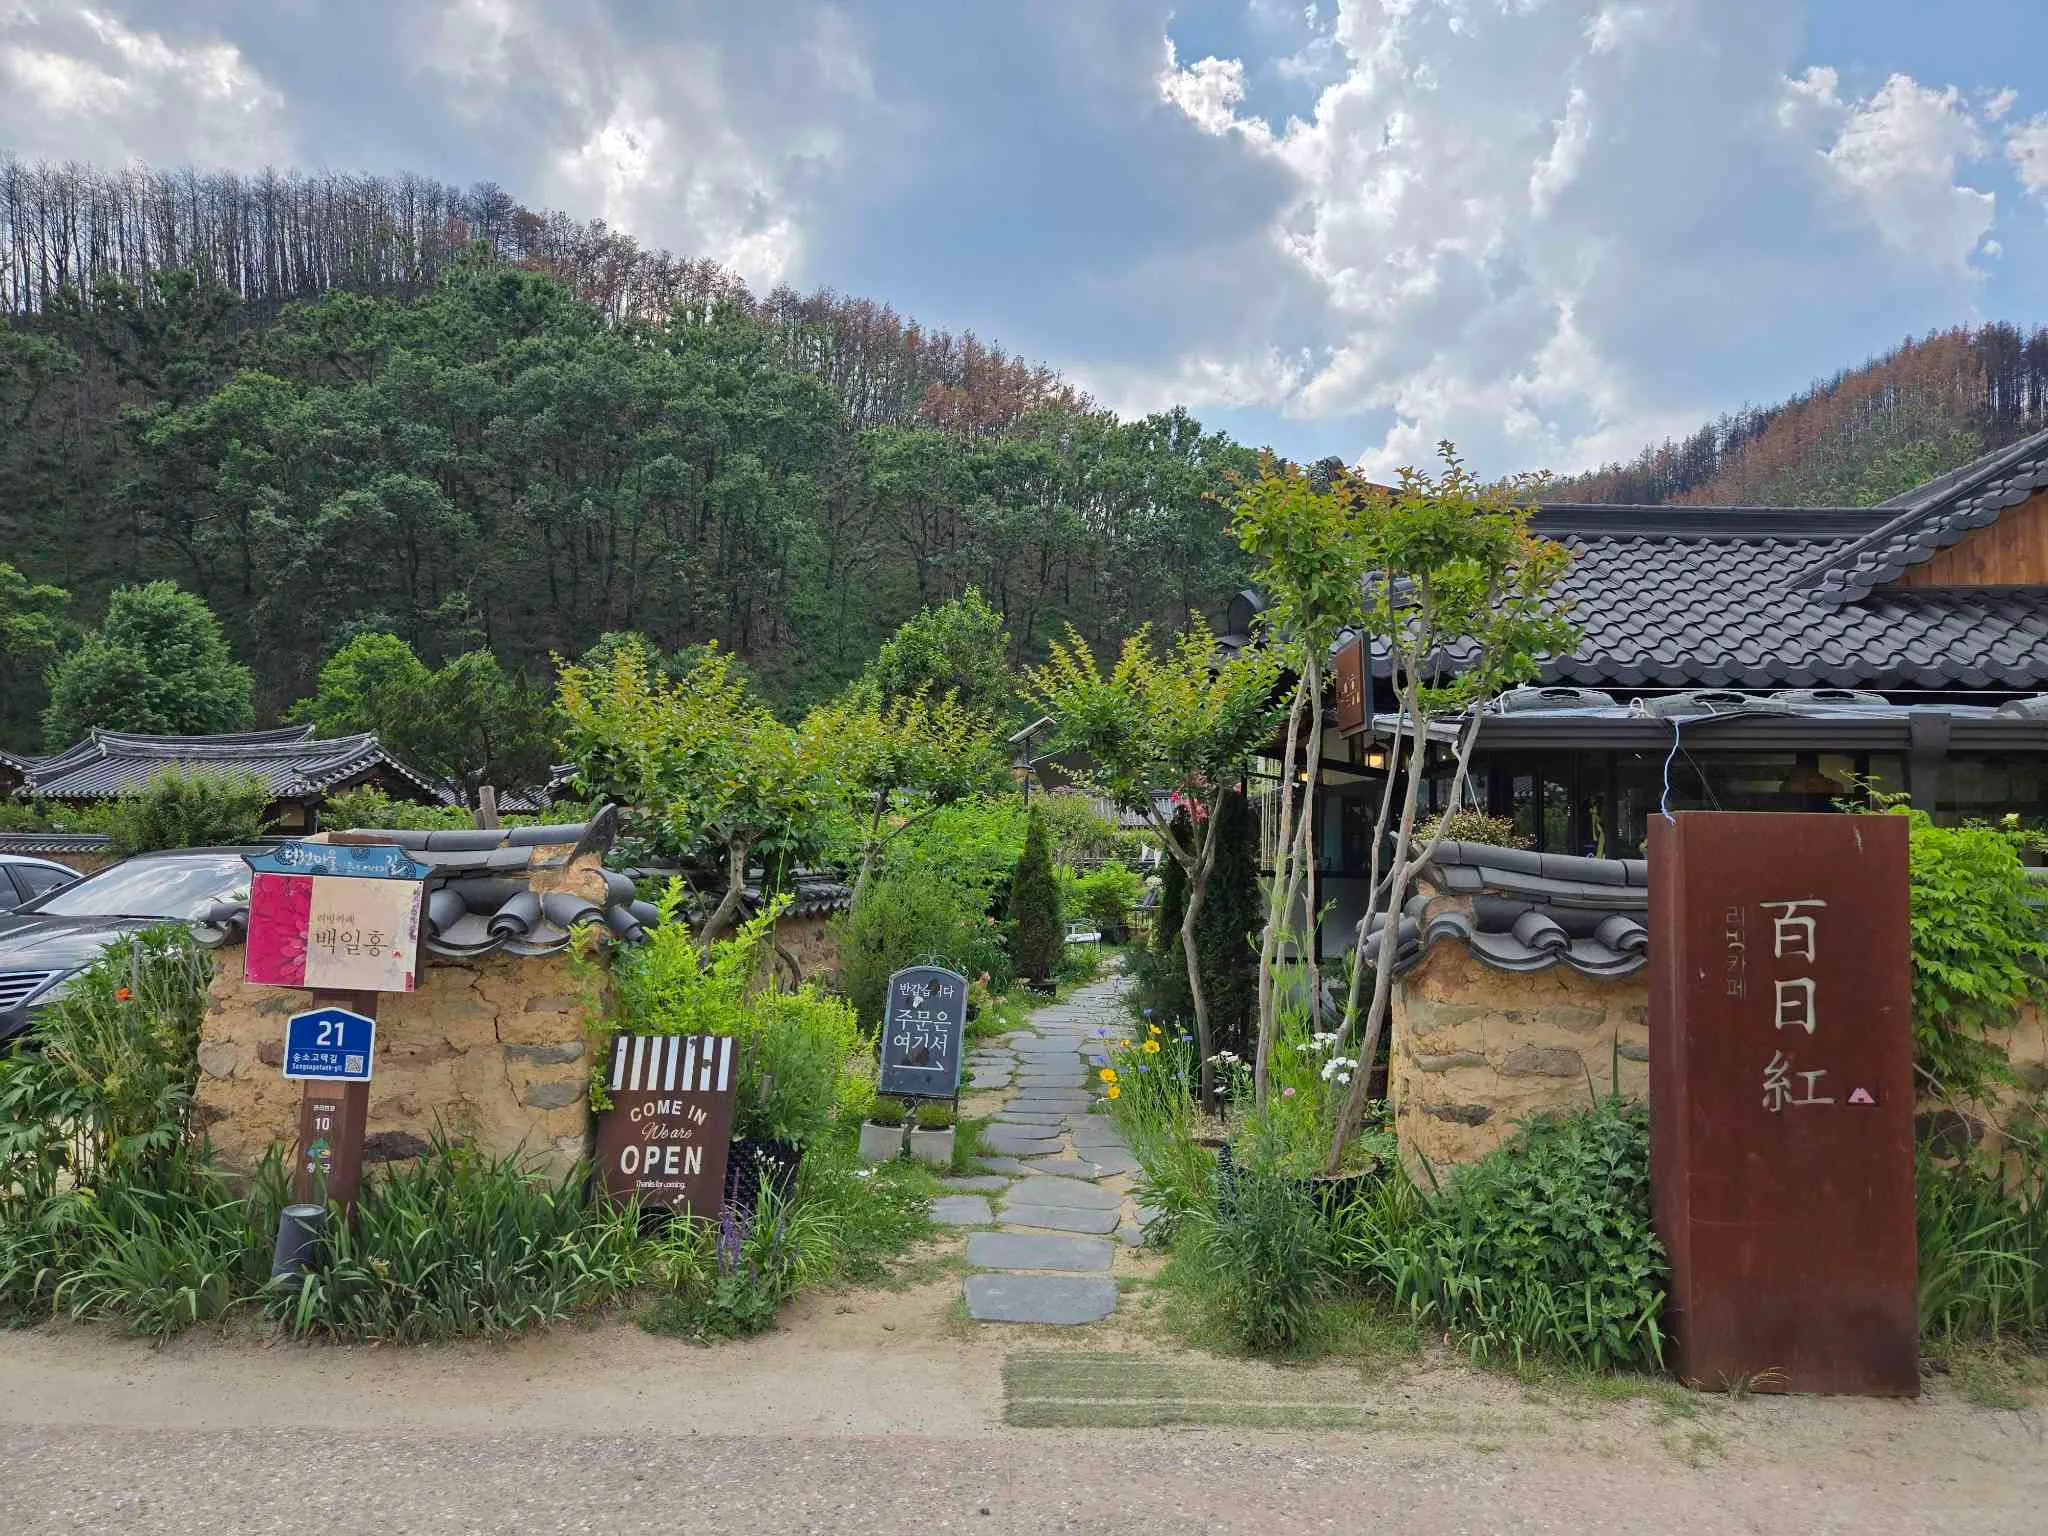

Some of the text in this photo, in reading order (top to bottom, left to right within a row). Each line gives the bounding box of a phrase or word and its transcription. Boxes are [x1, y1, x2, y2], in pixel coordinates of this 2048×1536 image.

[317, 928, 388, 957] 백일홍
[1760, 900, 1835, 1112] 百日紅
[896, 1009, 951, 1032] 주문은
[316, 1020, 345, 1047] 21
[894, 1032, 947, 1057] 여기서
[293, 1053, 338, 1064] 송소고택길
[315, 1117, 330, 1130] 10
[630, 1100, 708, 1126] COME IN
[641, 1121, 693, 1141] We are
[620, 1145, 703, 1175] OPEN
